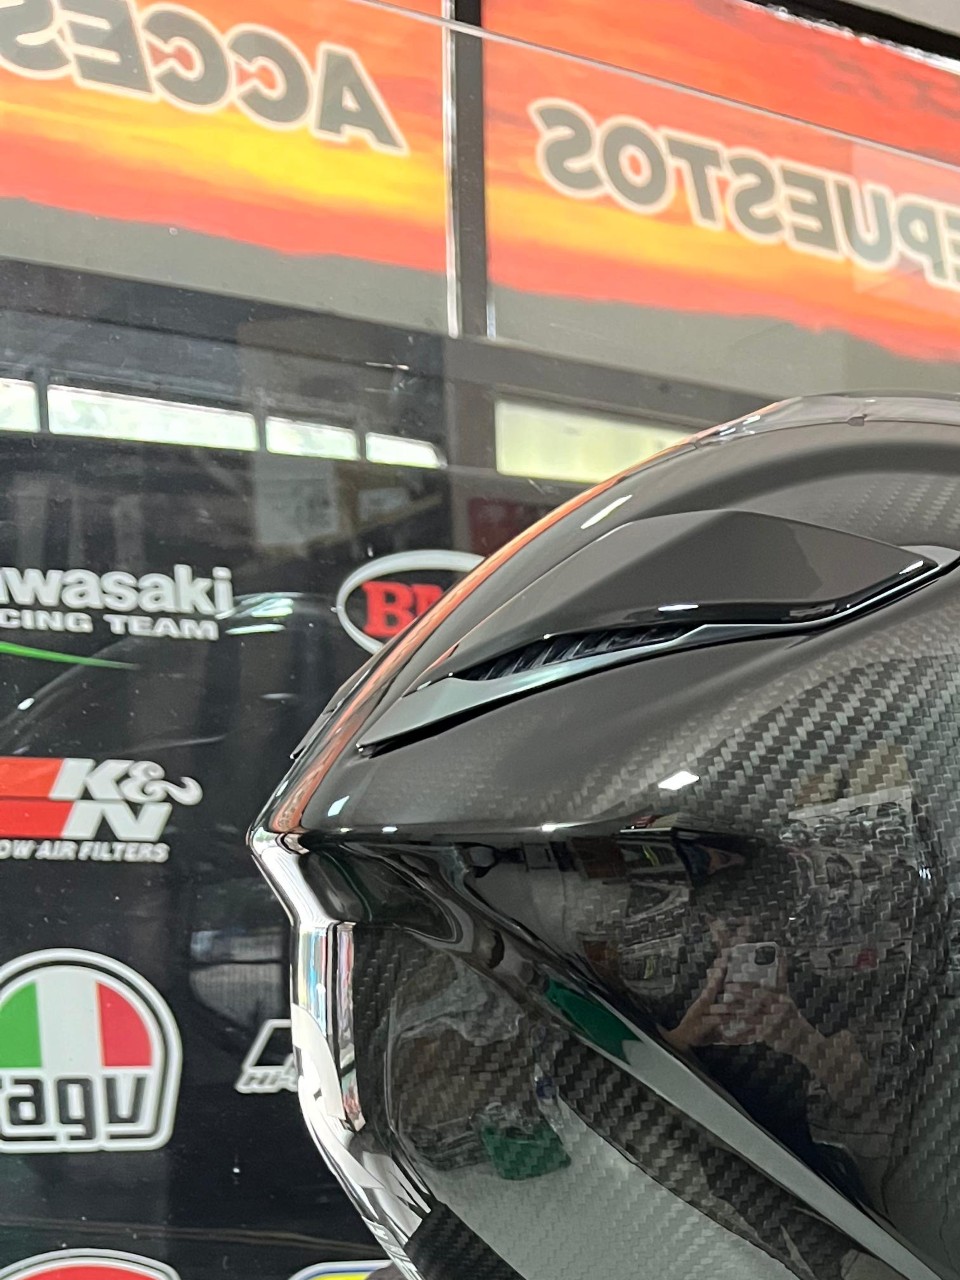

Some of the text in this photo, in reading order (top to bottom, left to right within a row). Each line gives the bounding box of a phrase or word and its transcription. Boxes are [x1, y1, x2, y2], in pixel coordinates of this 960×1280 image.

[103, 614, 219, 641] TEAM
[35, 840, 78, 860] AIR
[78, 841, 170, 863] FILTERS
[9, 1077, 147, 1140] agv
